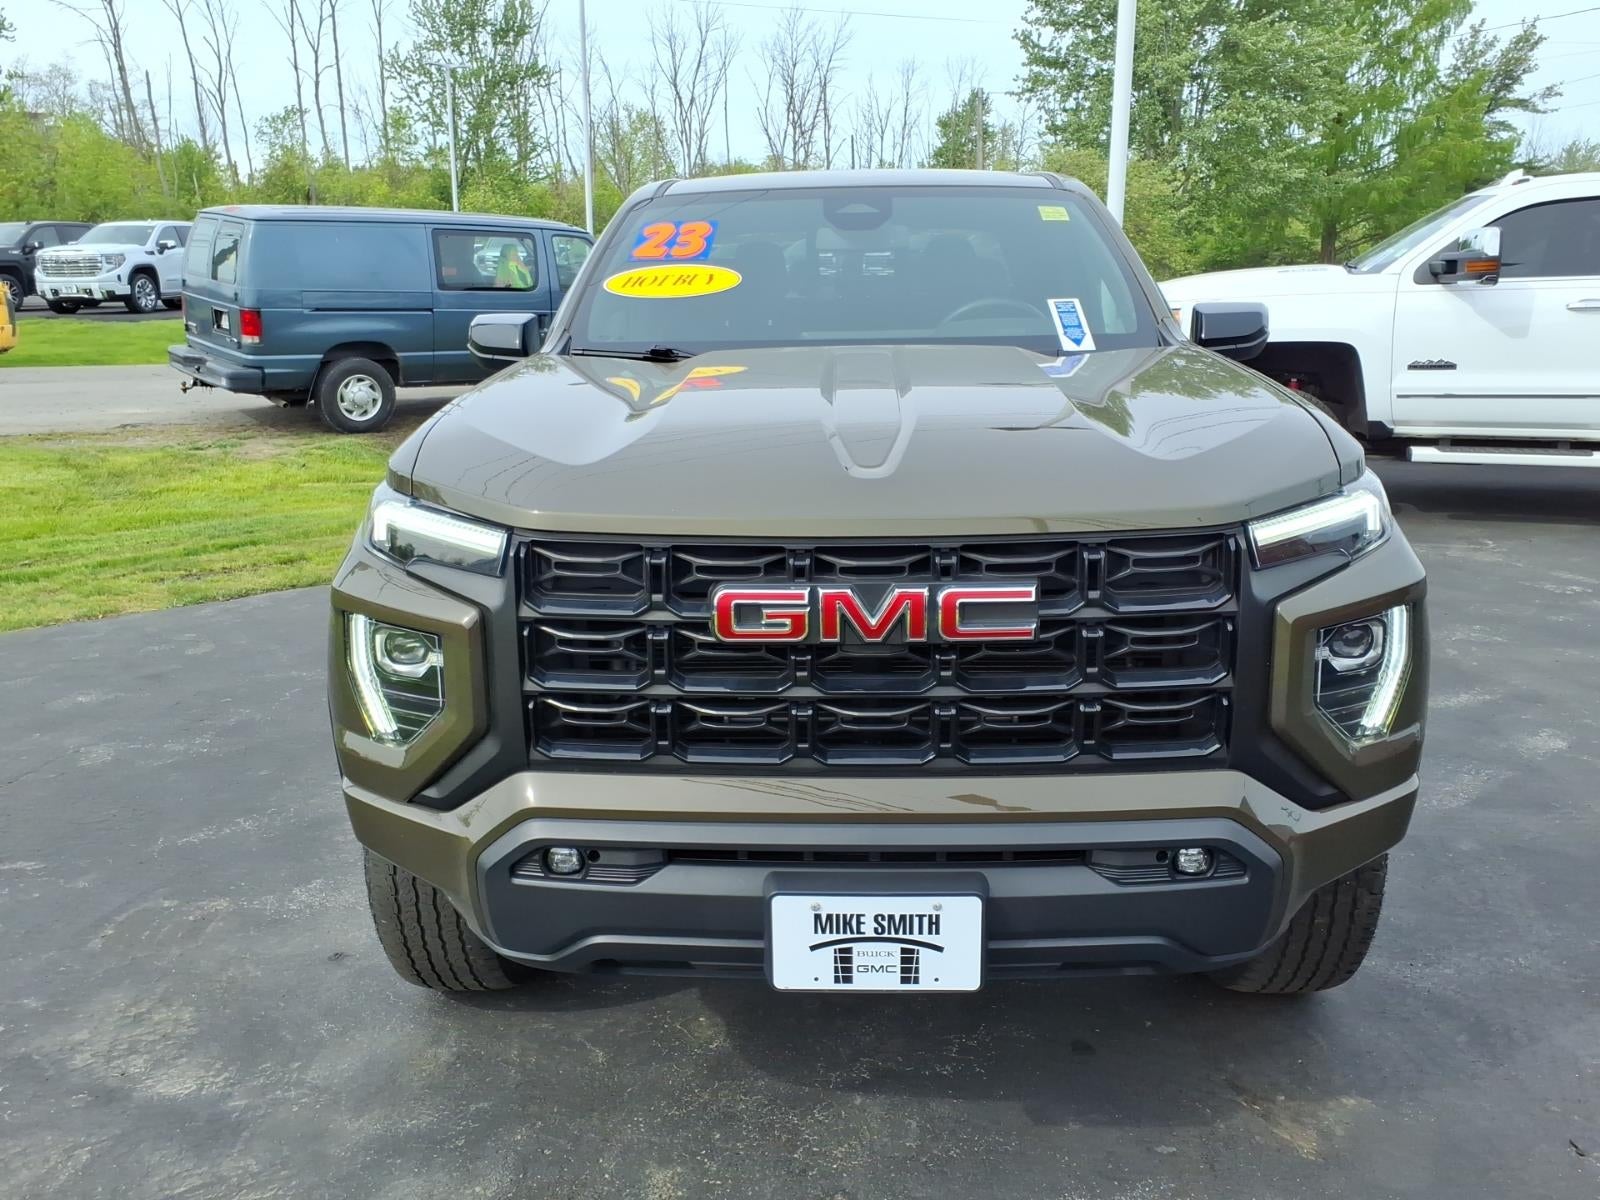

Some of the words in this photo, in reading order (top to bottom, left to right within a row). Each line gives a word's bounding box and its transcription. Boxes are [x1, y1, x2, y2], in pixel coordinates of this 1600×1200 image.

[632, 220, 713, 260] 23
[713, 586, 1037, 642] GMC
[813, 912, 867, 936] MIKE
[872, 912, 942, 937] SMITH
[856, 950, 896, 958] BUICK
[856, 964, 898, 974] GMC
